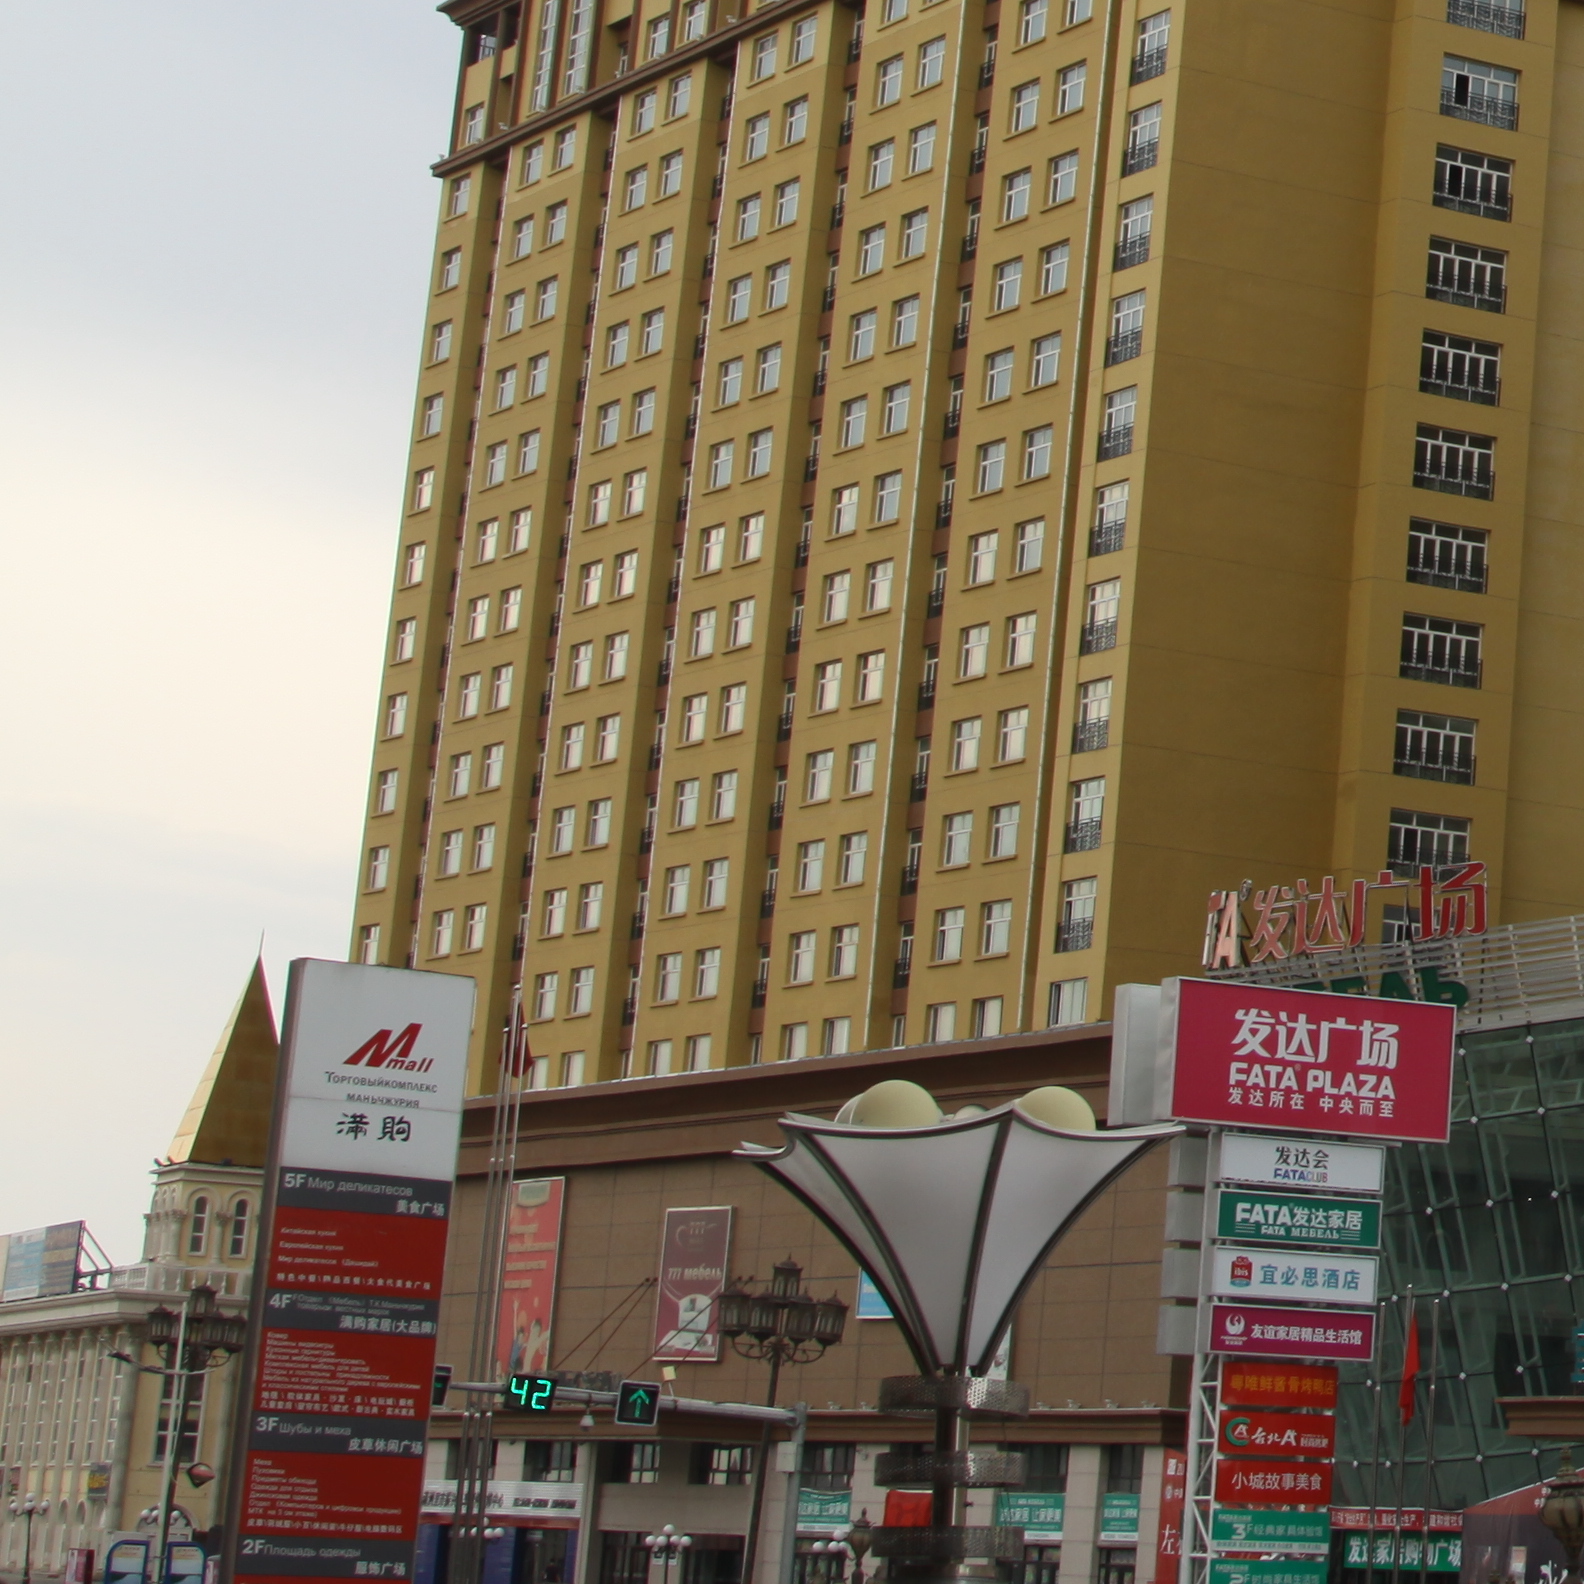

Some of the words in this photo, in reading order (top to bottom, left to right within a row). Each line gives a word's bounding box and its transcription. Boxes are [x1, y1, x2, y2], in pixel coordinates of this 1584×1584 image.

[1250, 861, 1487, 963] 发达广场
[1231, 1008, 1400, 1070] 发达广场
[1228, 1061, 1299, 1091] FATA
[1306, 1069, 1396, 1100] PLAZA
[346, 1093, 420, 1109] МАНЬЧЖУРИЯ
[1228, 1087, 1305, 1110] 发达所在
[1319, 1097, 1395, 1118] 中央而至
[1274, 1145, 1329, 1170] 发达会
[284, 1173, 306, 1188] 5F
[307, 1176, 335, 1191] Мир
[337, 1180, 413, 1196] деликатесов
[396, 1199, 445, 1216] 美食广场
[1235, 1202, 1293, 1226] FATA
[1293, 1205, 1363, 1231] 发达家居
[1261, 1225, 1286, 1236] FATA
[1233, 1266, 1249, 1277] ibis
[1260, 1264, 1361, 1291] 宜必思酒店
[269, 1293, 293, 1309] 4F
[1251, 1323, 1363, 1346] 友谊家居精品生活馆
[510, 1377, 552, 1411] 42
[256, 1416, 280, 1432] 3F
[279, 1422, 313, 1435] Шубы
[314, 1426, 322, 1434] и
[324, 1427, 352, 1436] меха
[348, 1437, 423, 1455] 皮草休闲广场
[1231, 1471, 1323, 1491] 小城故事美食
[242, 1539, 265, 1555] 2F
[355, 1561, 406, 1576] 服饰广场
